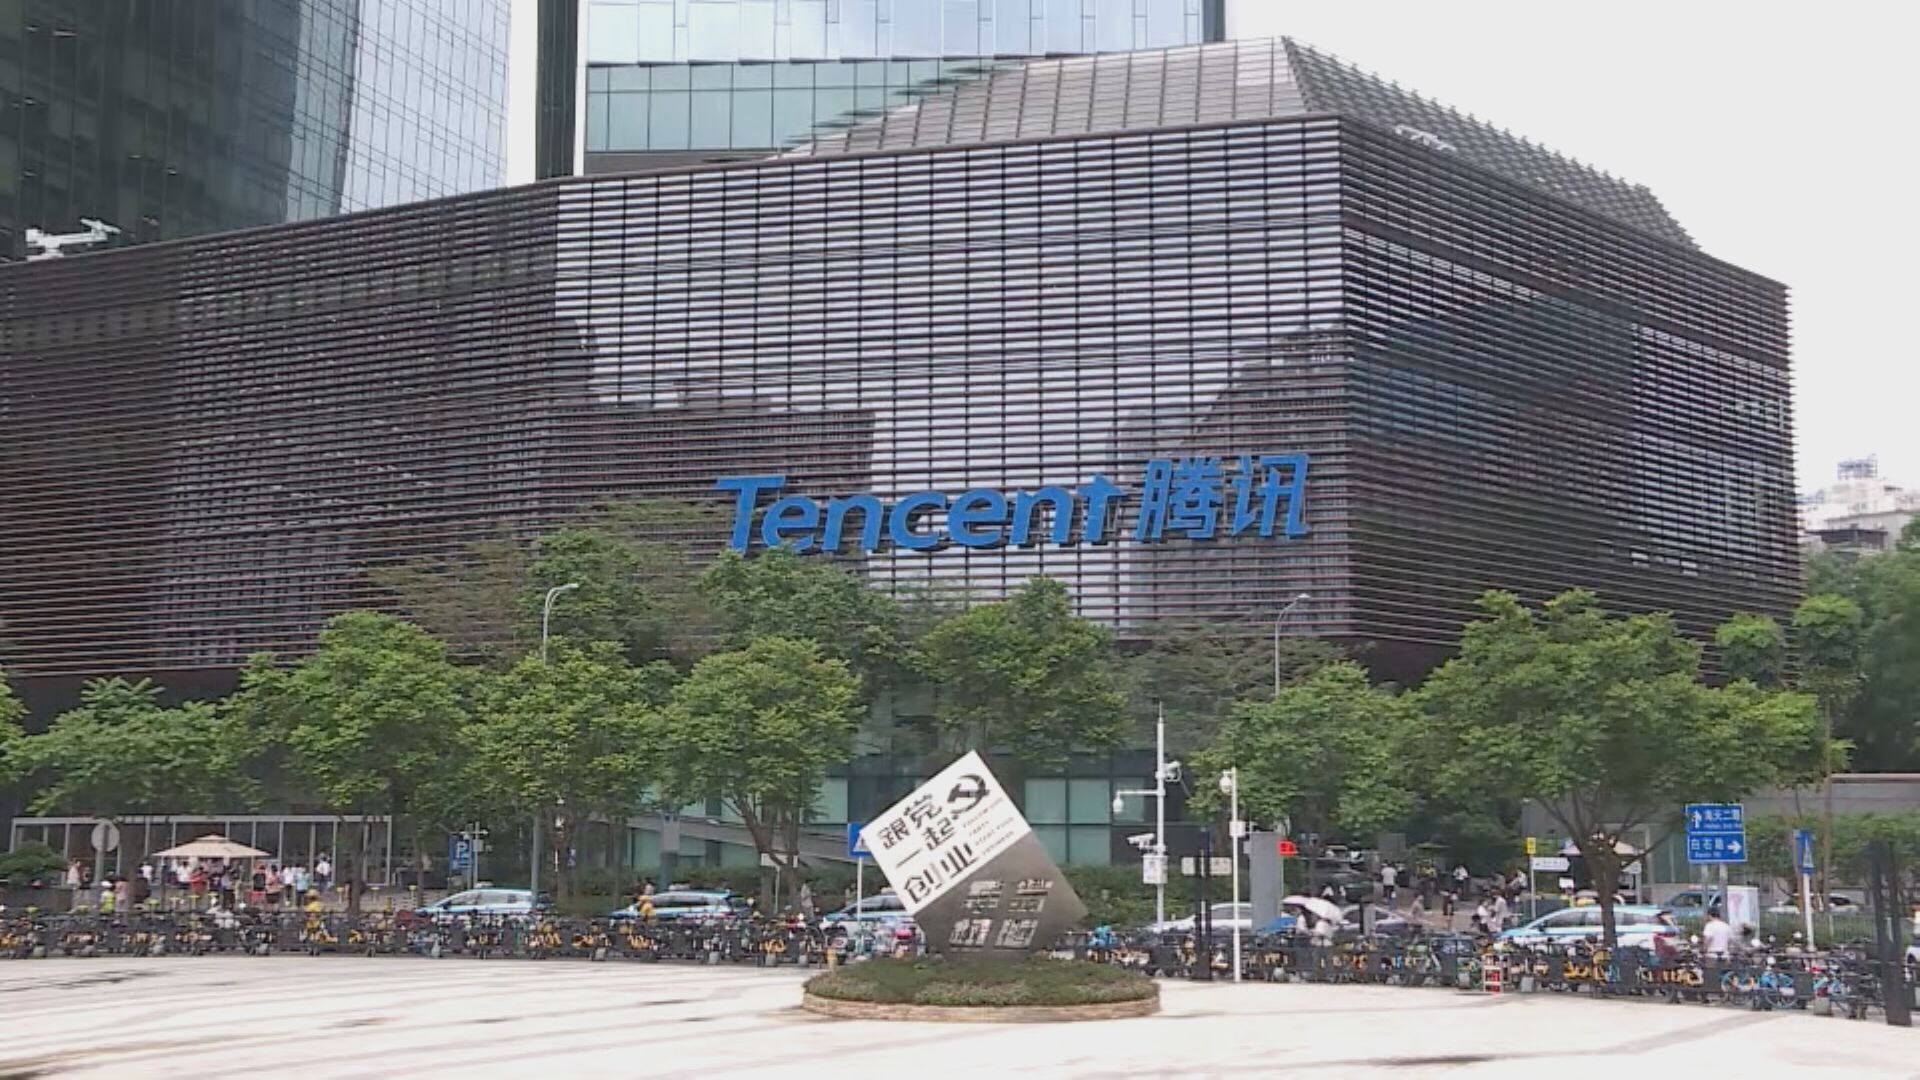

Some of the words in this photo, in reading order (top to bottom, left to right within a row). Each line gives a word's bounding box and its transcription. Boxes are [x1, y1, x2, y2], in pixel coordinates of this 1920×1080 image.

[713, 472, 1127, 554] Tencent
[1134, 454, 1310, 540] 腾讯
[878, 793, 943, 850] 跟党
[895, 821, 956, 868] 一起
[904, 842, 981, 904] 创业
